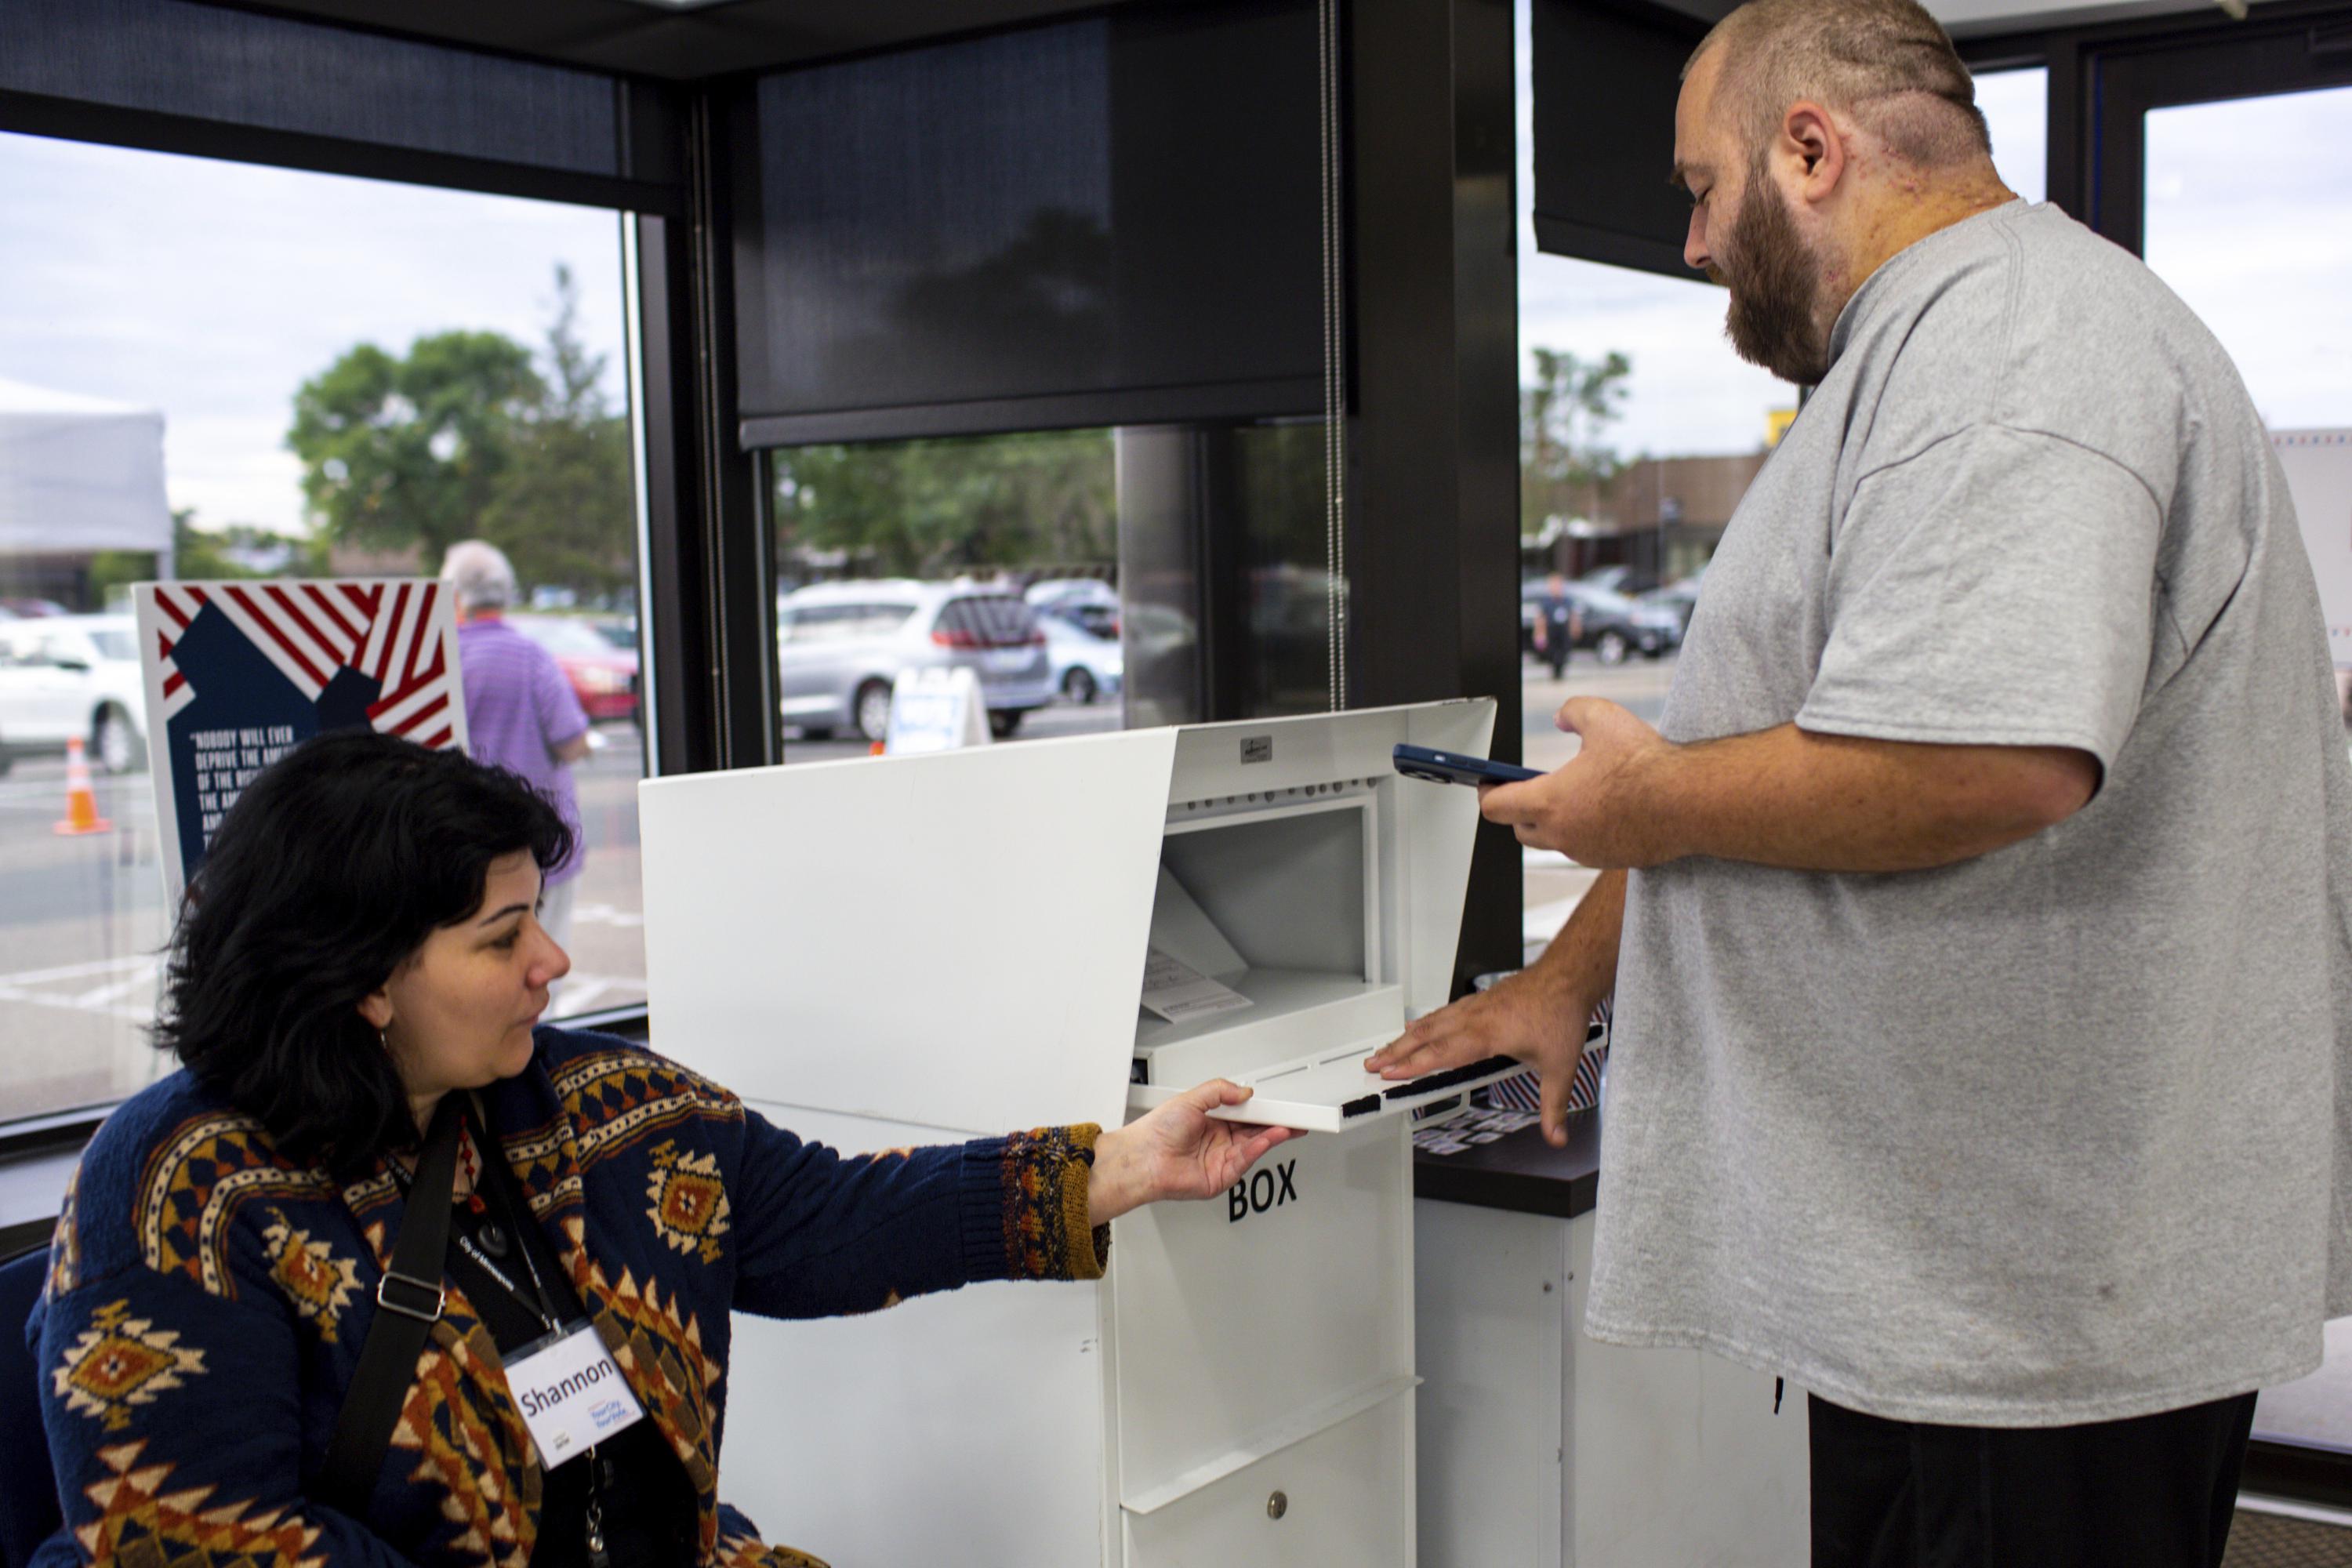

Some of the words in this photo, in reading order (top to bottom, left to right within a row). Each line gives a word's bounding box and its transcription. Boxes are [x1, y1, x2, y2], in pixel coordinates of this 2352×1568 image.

[239, 728, 265, 746] WILL
[267, 724, 293, 744] EVER
[195, 750, 237, 770] DEPRIVE
[241, 748, 260, 767] THE
[198, 772, 210, 791] OF
[214, 771, 233, 790] THE
[199, 793, 218, 811] THE
[1229, 1158, 1297, 1223] BOX
[521, 1359, 612, 1417] Shannon
